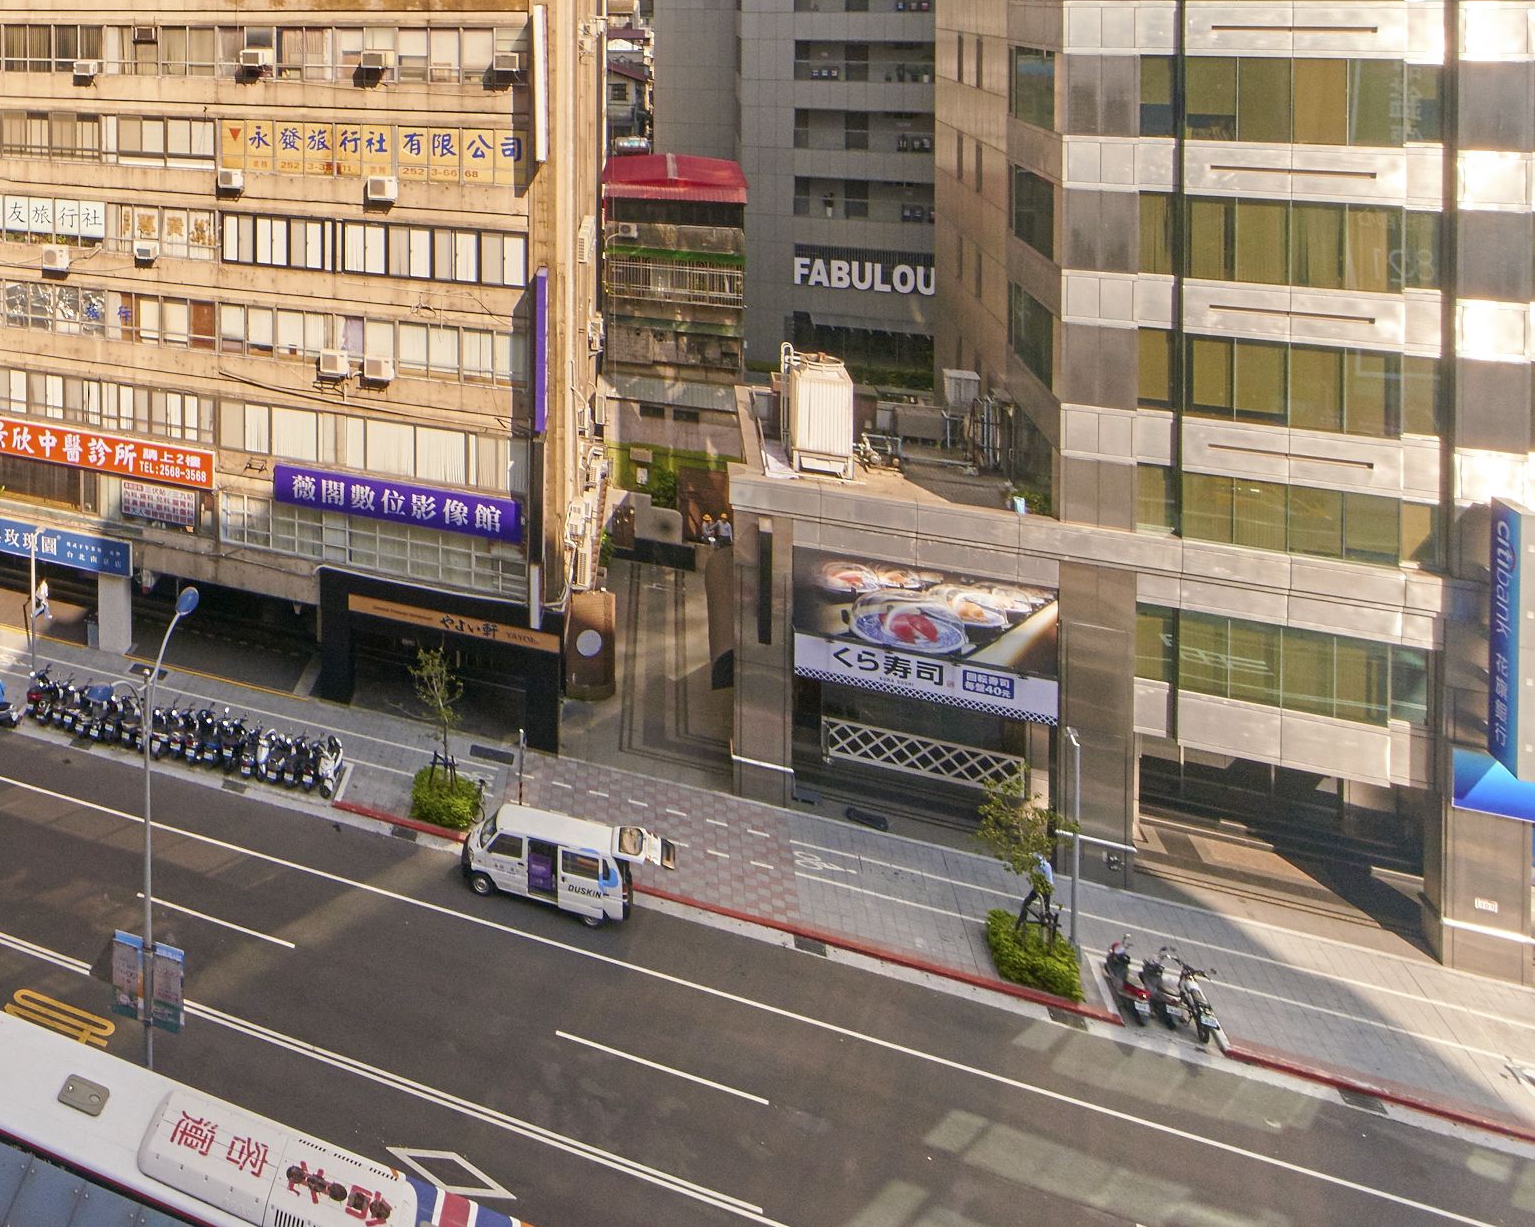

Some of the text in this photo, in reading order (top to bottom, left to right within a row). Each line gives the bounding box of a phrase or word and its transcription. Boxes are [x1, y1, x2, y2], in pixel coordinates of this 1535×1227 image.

[248, 125, 522, 163] 永發旅行社有限公司
[793, 256, 936, 296] FABULOU
[139, 460, 207, 483] TEL:2568-3568
[291, 473, 503, 534] 薇閣數位影像館
[1492, 520, 1515, 638] citibank
[440, 613, 498, 639] やよい軒
[832, 646, 944, 686] くら寿司
[567, 883, 602, 900] DUSKIN
